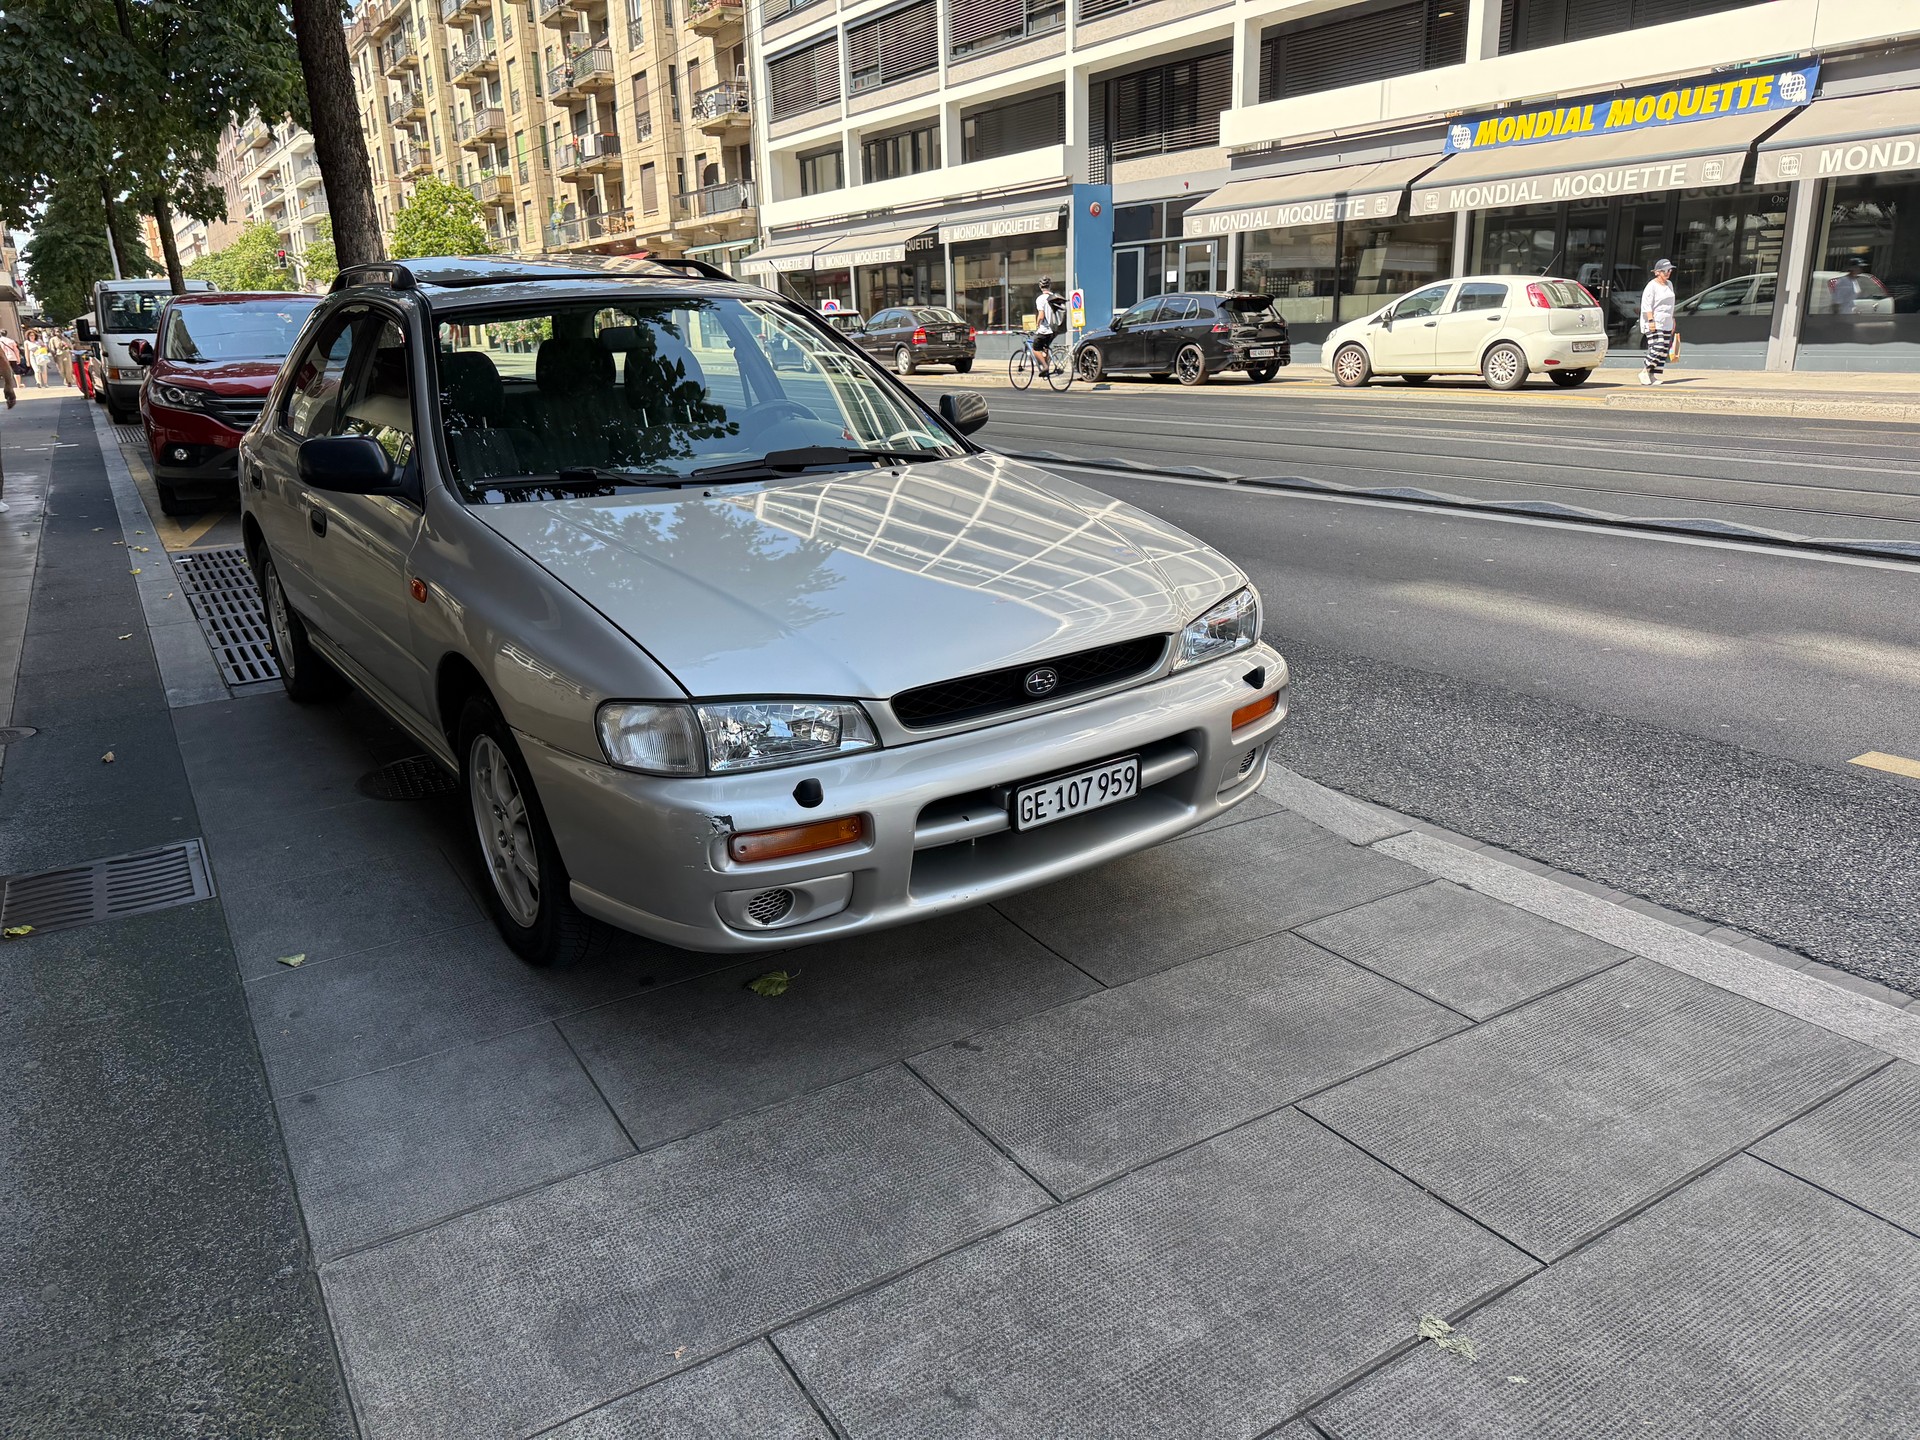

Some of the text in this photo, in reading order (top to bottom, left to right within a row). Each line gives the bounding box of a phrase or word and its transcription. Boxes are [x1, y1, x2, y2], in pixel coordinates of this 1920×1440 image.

[1473, 104, 1595, 147] MONDIAL
[1604, 74, 1774, 128] MOQUETTE
[1449, 180, 1543, 209] MONDIAL
[1551, 163, 1687, 198] MOQUETTE
[953, 217, 1040, 240] MONDIAL MOQUETTE
[1208, 211, 1271, 233] MONDIAL
[1276, 199, 1366, 225] MOQUETTE
[825, 249, 891, 268] MONDIAL MOQUETTE
[1098, 766, 1136, 801] 959
